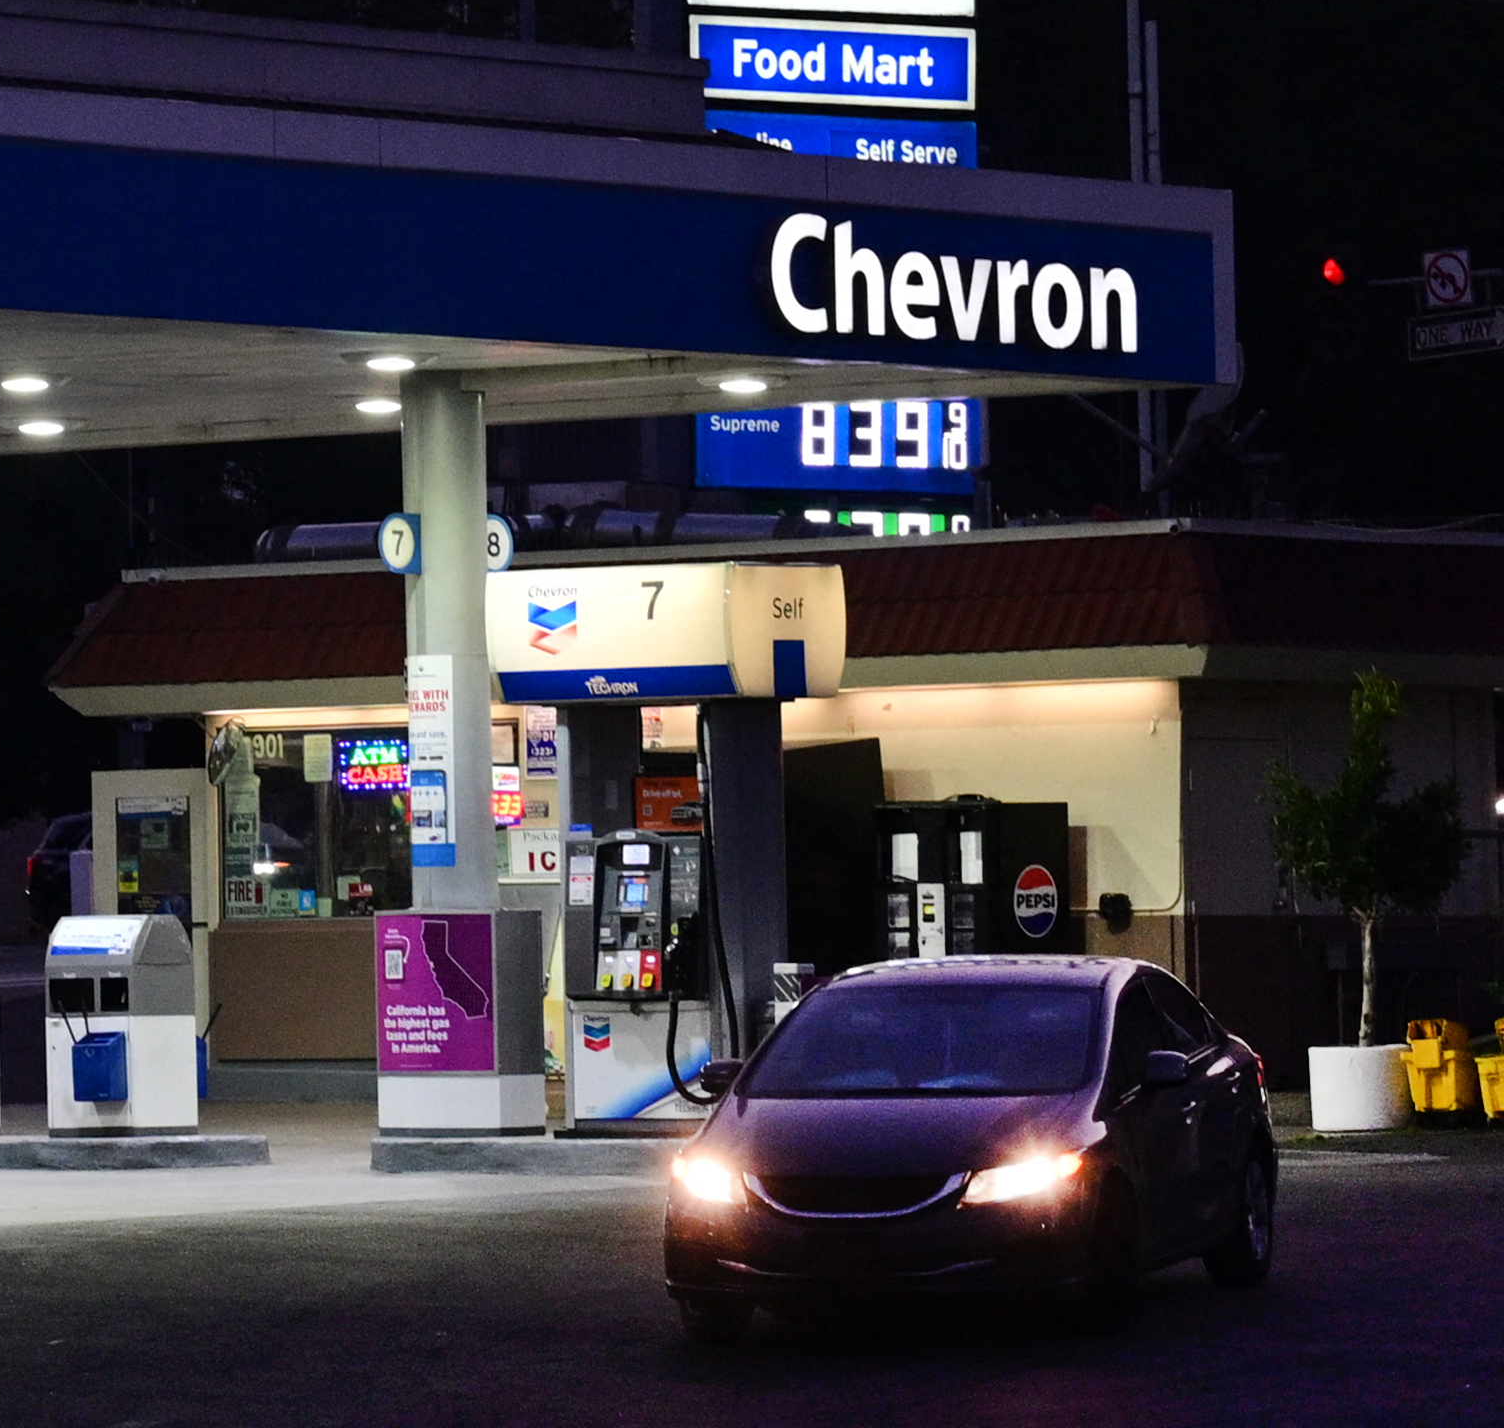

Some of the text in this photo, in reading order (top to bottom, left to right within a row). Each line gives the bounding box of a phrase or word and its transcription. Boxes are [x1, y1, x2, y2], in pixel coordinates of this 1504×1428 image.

[732, 38, 934, 87] Food Mart
[856, 138, 958, 164] Self Serve
[770, 212, 1138, 353] Chevron
[1417, 319, 1493, 346] ONE WAY
[710, 414, 780, 435] Supreme
[392, 530, 404, 556] 7
[487, 532, 500, 557] 8
[528, 585, 578, 598] Chevron
[641, 580, 664, 620] 7
[772, 596, 804, 621] Self
[423, 689, 449, 701] WITH
[584, 680, 639, 695] TECHRON
[253, 733, 284, 759] 901
[350, 746, 399, 765] ATM
[347, 765, 404, 784] CASH
[227, 880, 253, 903] FIRE
[1016, 893, 1055, 909] PEPSI
[386, 1005, 446, 1016] California has
[384, 1017, 450, 1030] the highest gas
[386, 1029, 448, 1041] taxes and fees
